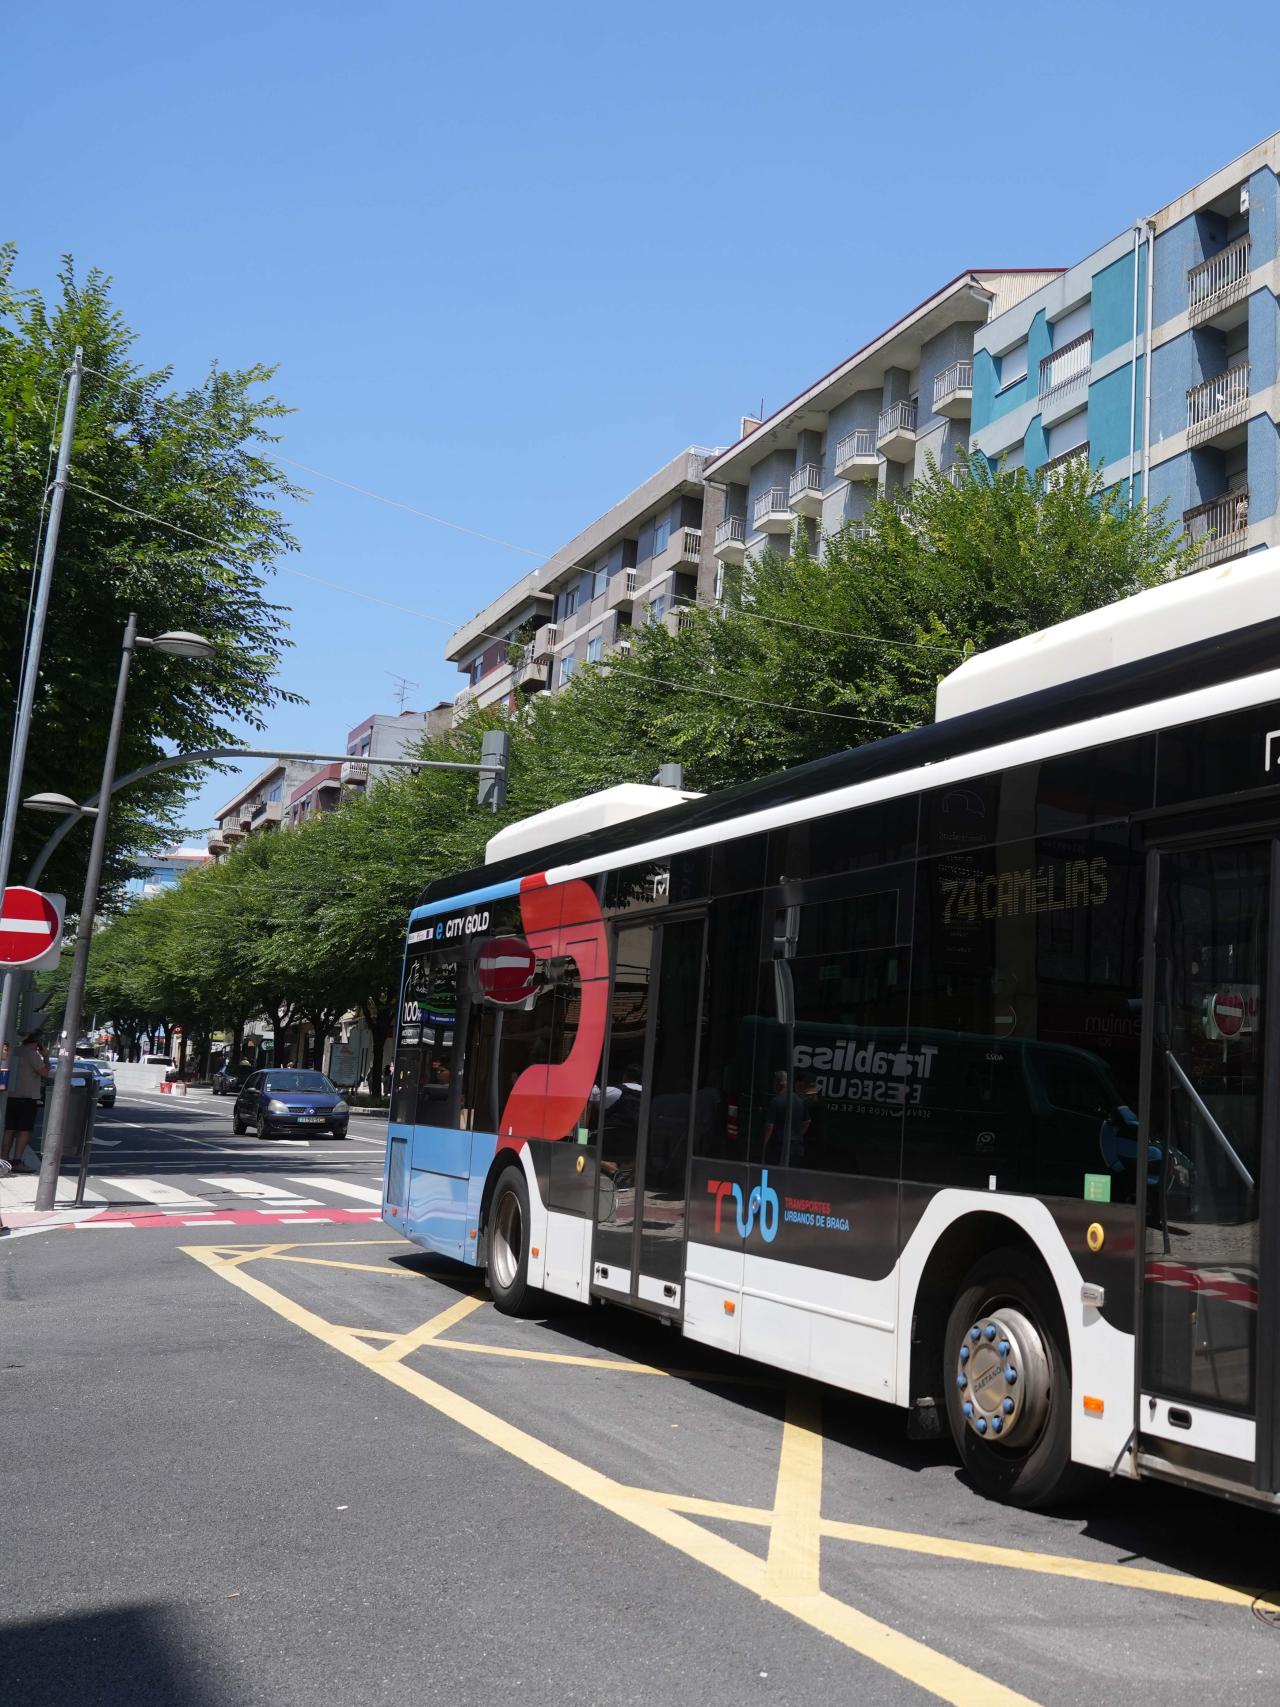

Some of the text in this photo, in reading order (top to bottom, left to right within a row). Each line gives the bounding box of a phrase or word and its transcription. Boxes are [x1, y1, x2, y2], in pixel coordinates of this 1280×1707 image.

[445, 917, 466, 938] CITY
[465, 911, 490, 934] GOLD
[784, 1197, 831, 1214] TRANSPORTES
[784, 1210, 850, 1231] URBANOS DE BRAGA
